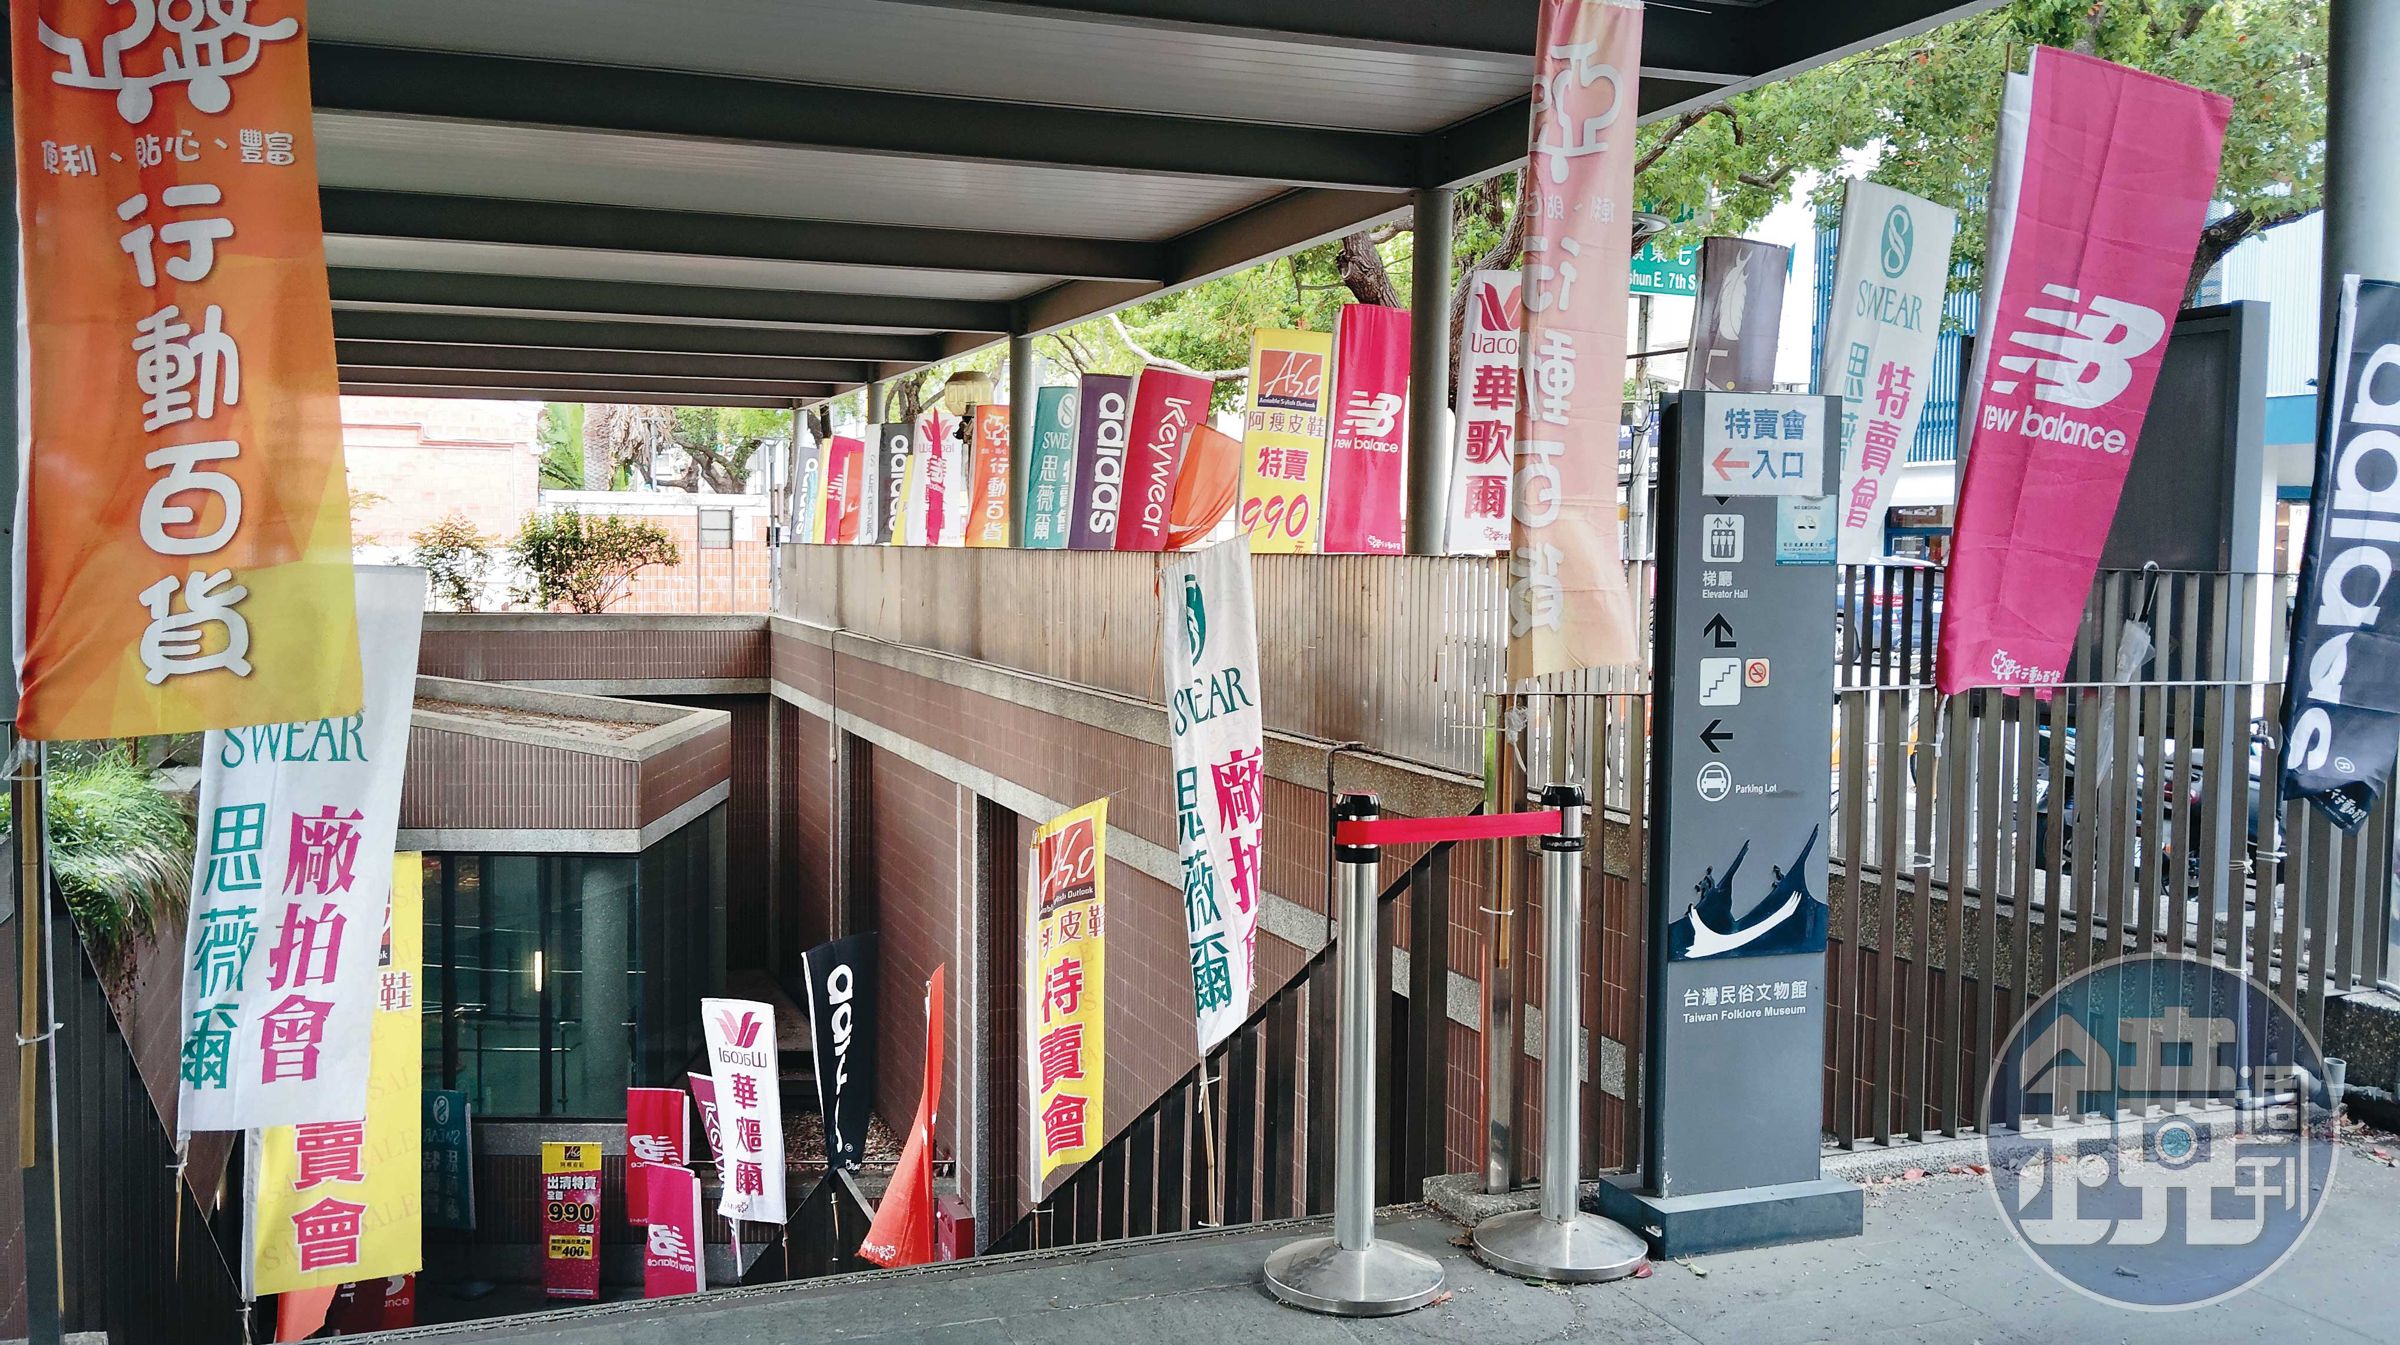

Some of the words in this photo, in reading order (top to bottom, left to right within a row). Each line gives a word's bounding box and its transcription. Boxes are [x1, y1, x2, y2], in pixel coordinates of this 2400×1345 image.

[1668, 272, 1687, 290] 7th
[1856, 279, 1923, 333] SWEAR
[117, 183, 253, 687] 行動百貨
[1247, 411, 1326, 438] 阿瘦皮鞋
[1725, 408, 1807, 441] 特賣會
[2020, 405, 2127, 454] balance
[1334, 438, 1351, 449] new
[1353, 437, 1399, 454] balance
[1464, 364, 1516, 521] 華歌爾
[1845, 360, 1916, 529] 特賣會
[1089, 391, 1127, 535] adidas
[1141, 397, 1192, 537] Keywear
[1257, 446, 1309, 481] 特賣
[1751, 449, 1804, 480] 入口
[984, 456, 1010, 541] 行動百貨
[1033, 454, 1058, 541] 思薇爾
[1241, 493, 1310, 540] 990
[1702, 570, 1733, 587] 梯廳
[1702, 589, 1731, 599] Elevator
[1733, 589, 1749, 599] Hall
[220, 716, 369, 769] SWEAR
[1735, 784, 1761, 794] Parking
[1762, 783, 1777, 793] Lot
[1067, 886, 1094, 899] Outlook
[178, 801, 268, 1091] 思薇爾
[257, 804, 365, 1085] 廠拍會
[1683, 980, 1808, 1008] 台灣民俗文物館
[1683, 1011, 1719, 1024] Taiwan
[1721, 1008, 1762, 1020] Folklore
[1764, 1005, 1807, 1017] Museum
[548, 1202, 595, 1223] 990
[562, 1246, 585, 1257] 400
